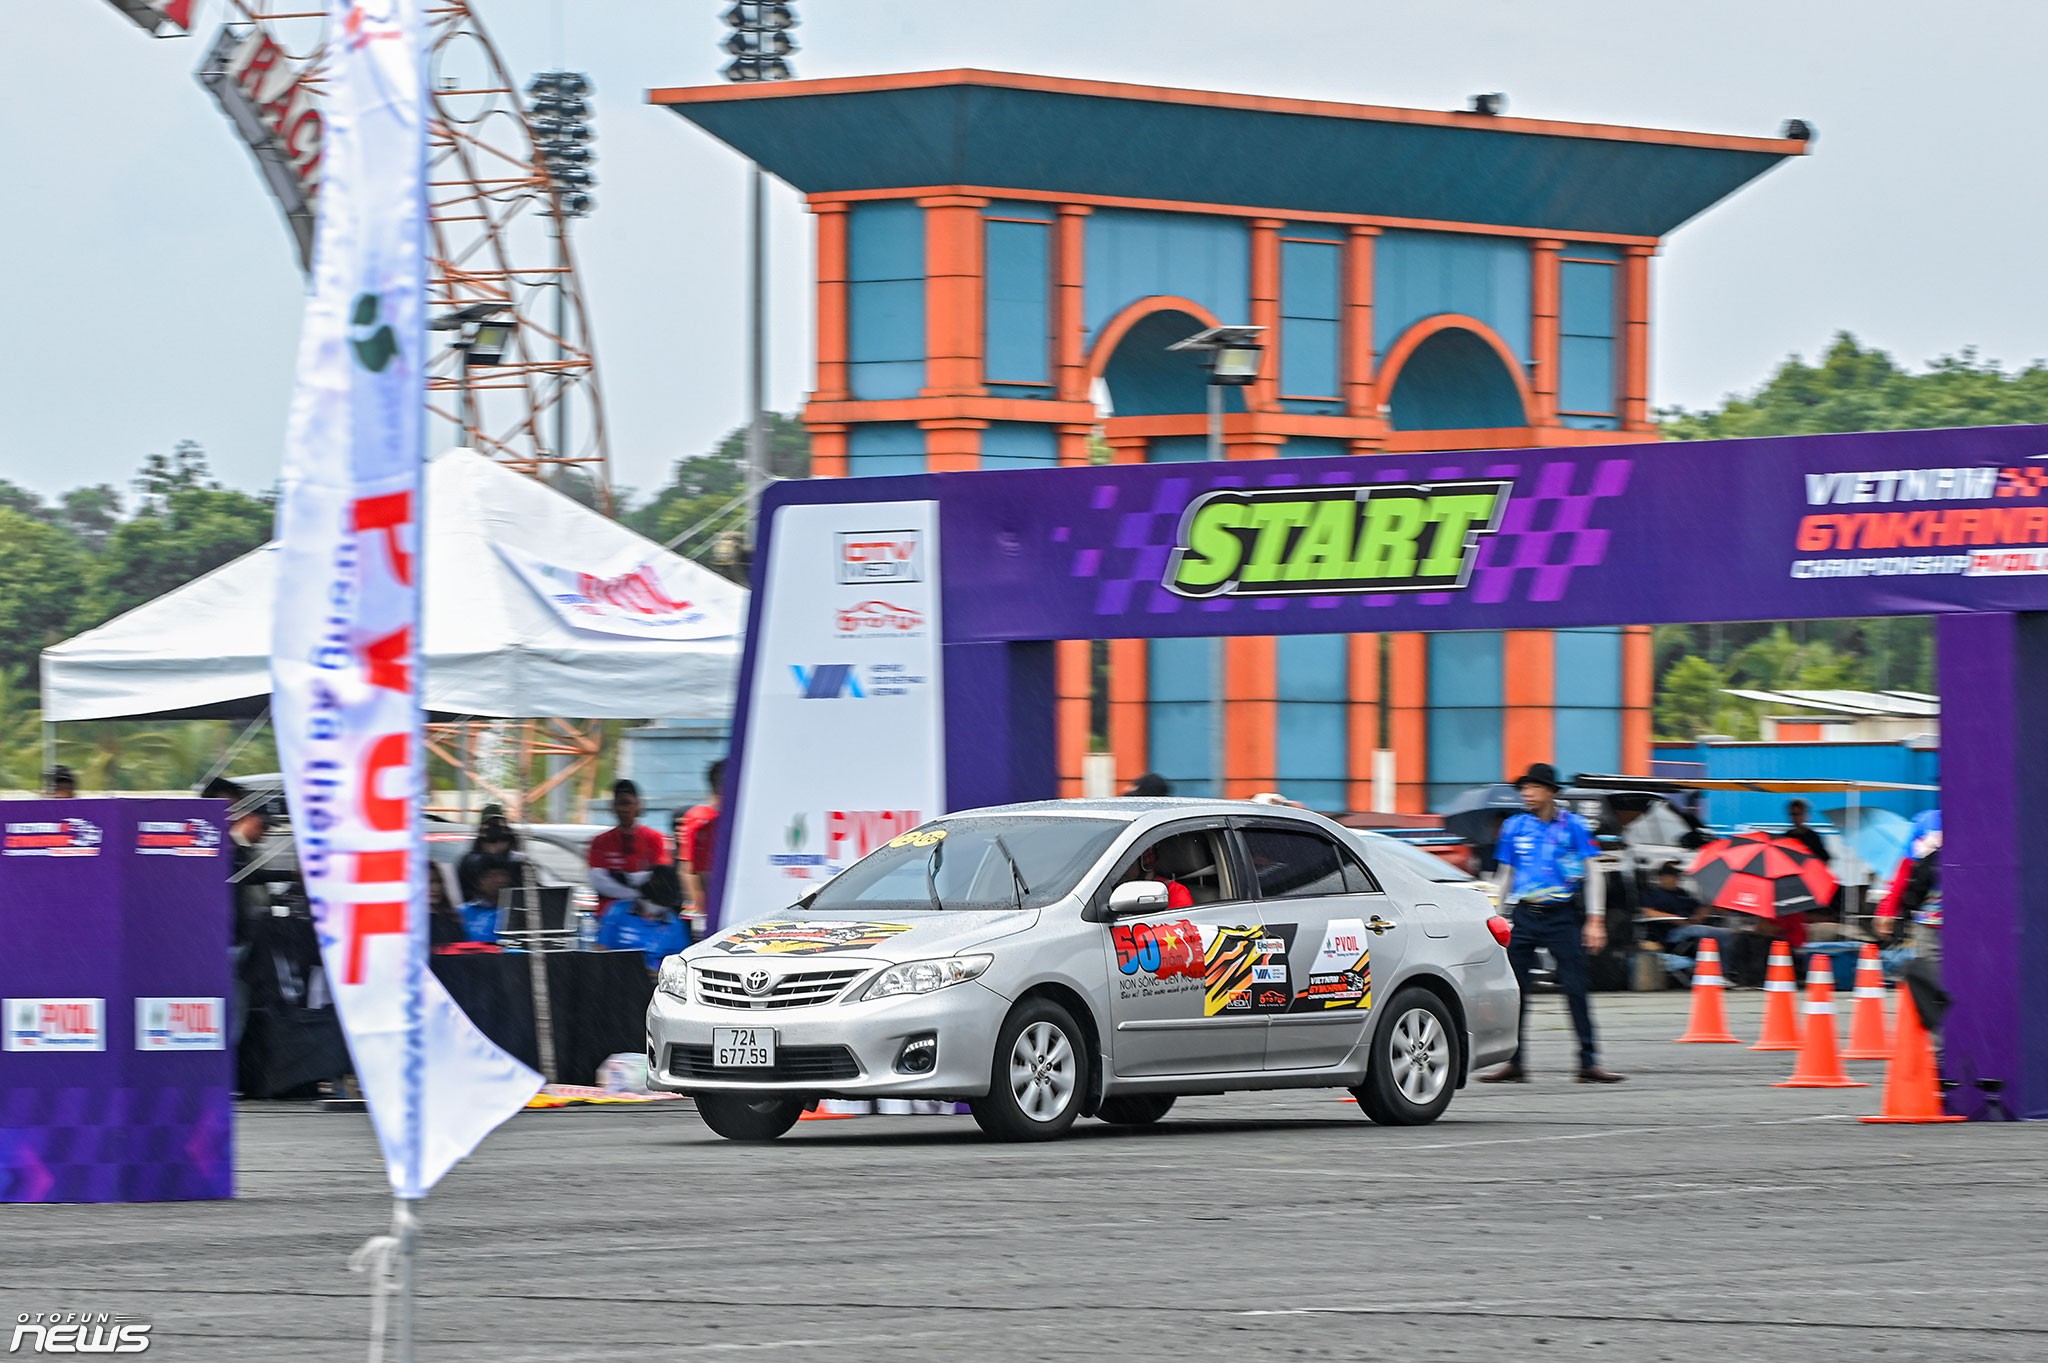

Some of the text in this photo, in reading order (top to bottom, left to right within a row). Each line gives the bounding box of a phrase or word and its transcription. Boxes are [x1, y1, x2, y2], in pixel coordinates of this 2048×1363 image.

[1804, 467, 1999, 505] VIETNAM
[1174, 493, 1498, 586] START
[1109, 923, 1162, 976] 50
[1335, 935, 1360, 952] PVOIL
[1119, 978, 1137, 990] NON
[1310, 975, 1340, 985] VIETNAM
[730, 1029, 756, 1046] 72A
[720, 1048, 768, 1065] 677.59
